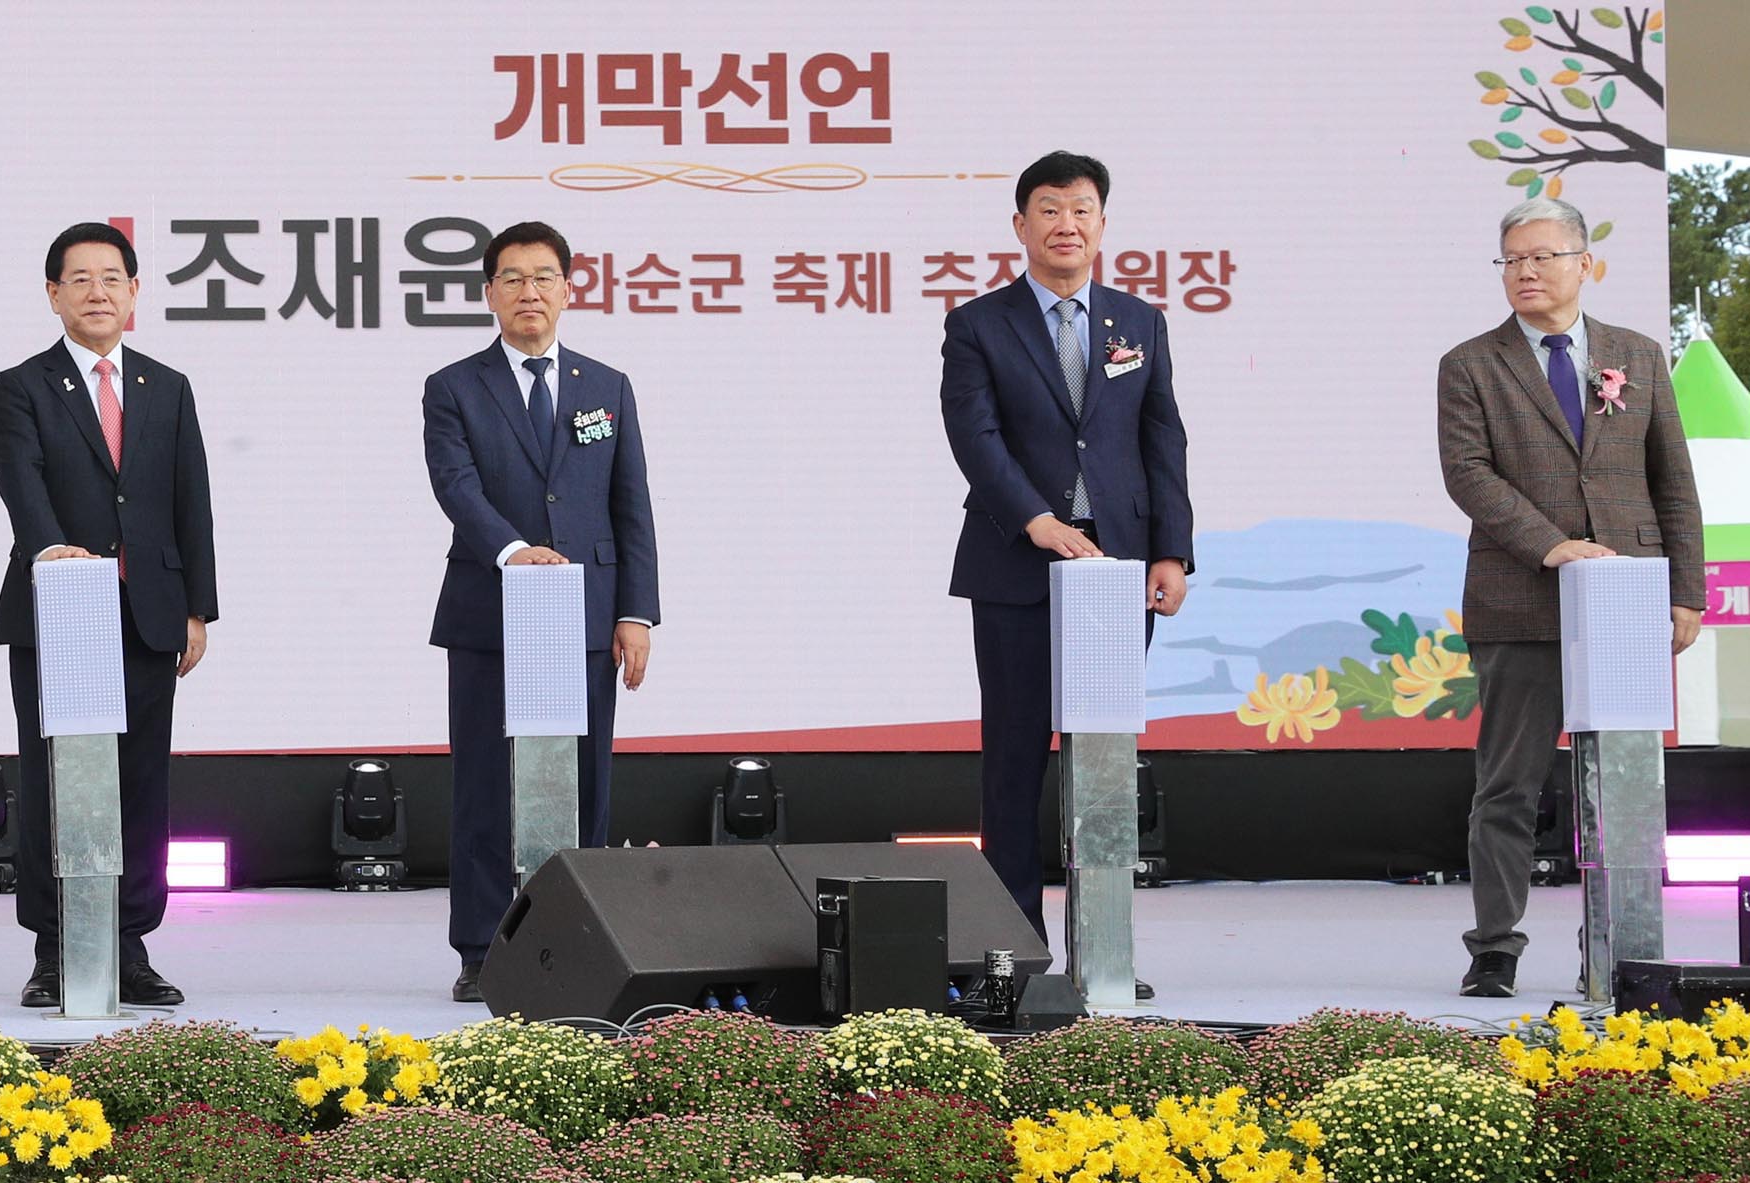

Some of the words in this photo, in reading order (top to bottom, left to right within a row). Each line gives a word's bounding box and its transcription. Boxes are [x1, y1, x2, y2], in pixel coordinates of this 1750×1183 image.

[493, 52, 892, 147] 개막선언
[164, 217, 494, 329] 조재윤
[566, 253, 744, 313] 화순군
[772, 252, 891, 314] 축제
[921, 251, 1236, 314] 추원장
